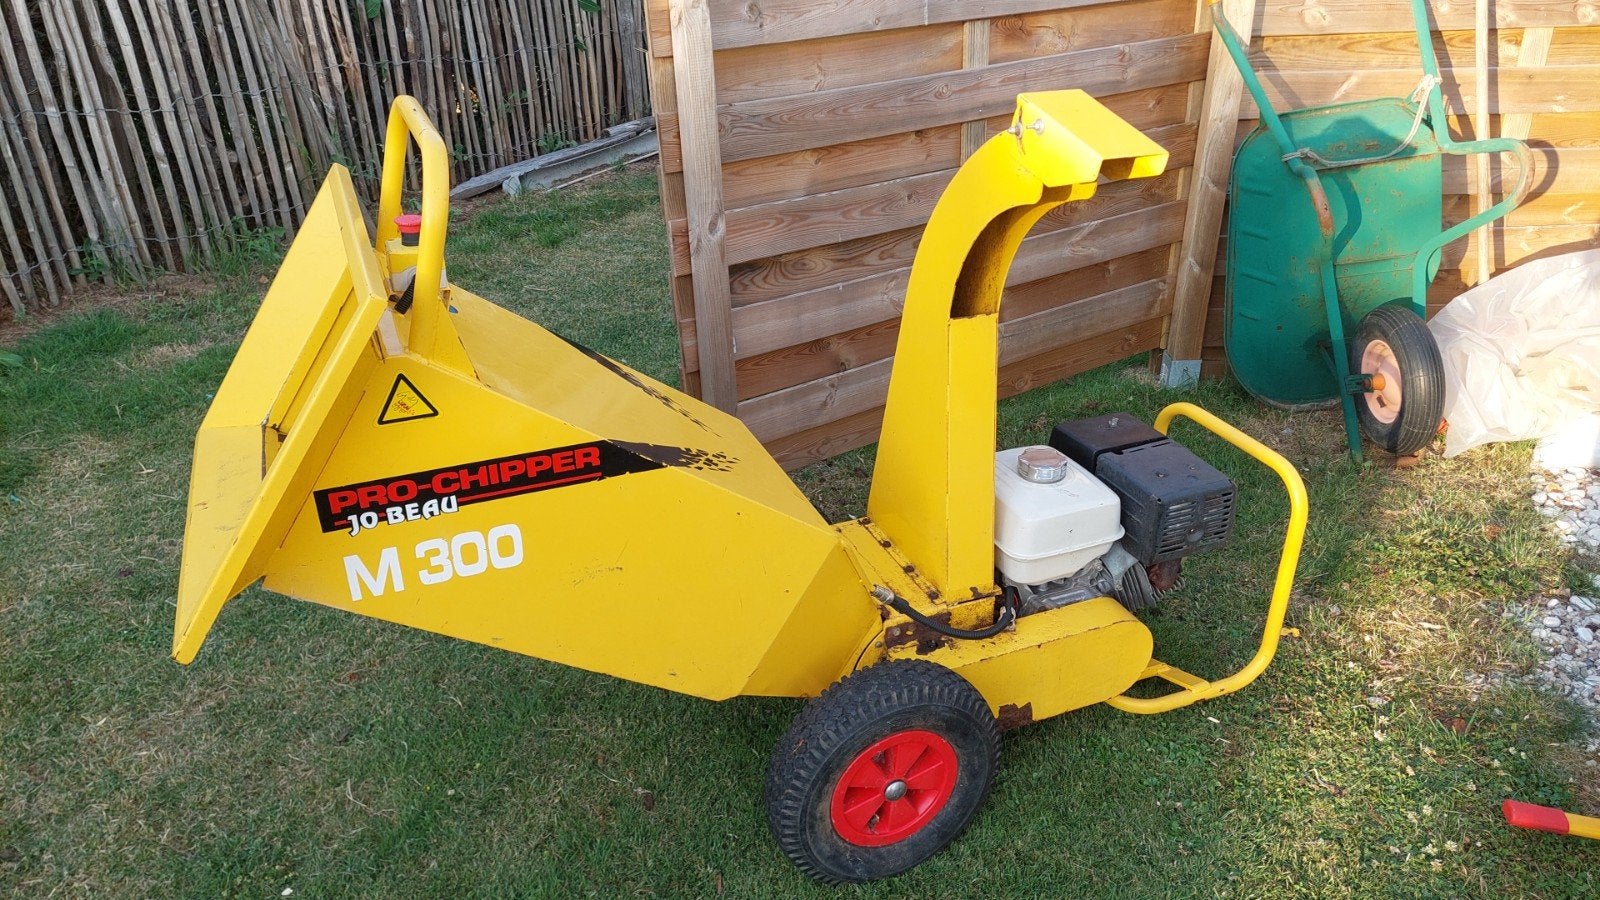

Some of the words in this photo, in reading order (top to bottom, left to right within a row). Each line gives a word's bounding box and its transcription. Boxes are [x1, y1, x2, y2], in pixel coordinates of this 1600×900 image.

[328, 446, 601, 514] PRO-CHIPPER
[343, 546, 405, 602] M
[415, 523, 524, 586] 300
